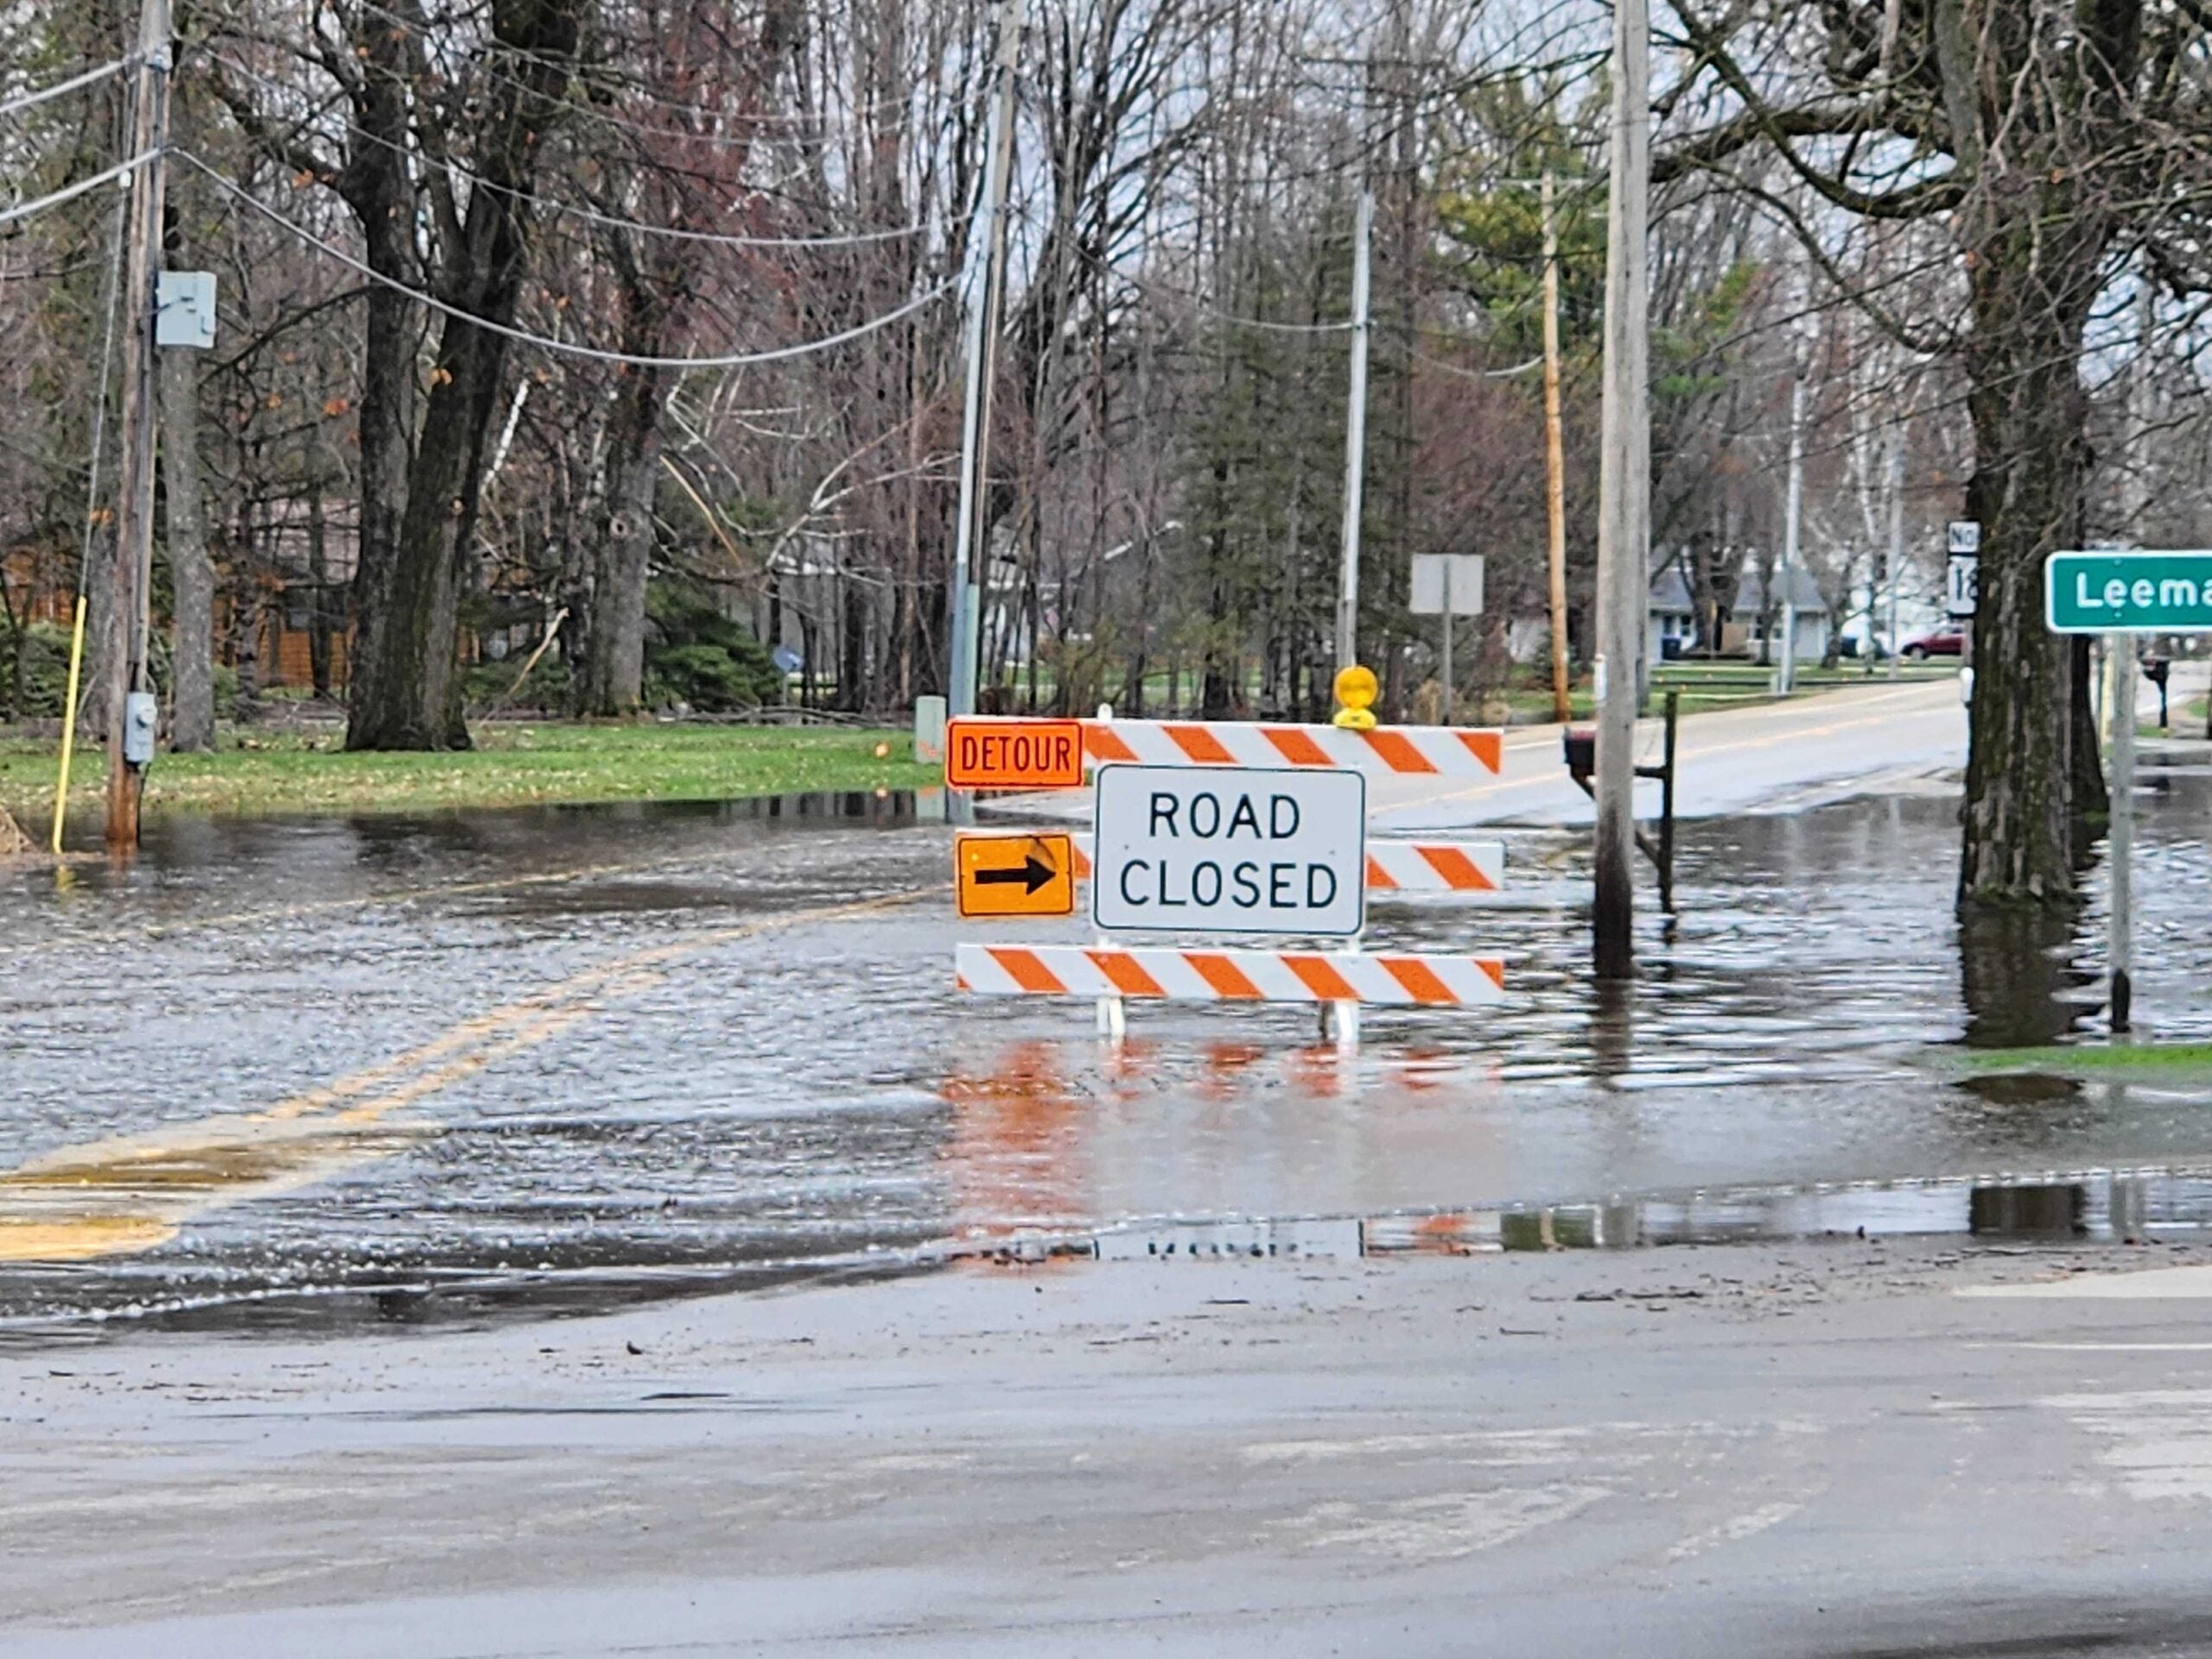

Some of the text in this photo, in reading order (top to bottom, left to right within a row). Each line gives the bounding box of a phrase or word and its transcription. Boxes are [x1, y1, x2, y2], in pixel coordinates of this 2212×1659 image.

[962, 735, 1071, 772] DETOUR
[1149, 791, 1300, 839] ROAD
[1120, 860, 1338, 908] CLOSED
